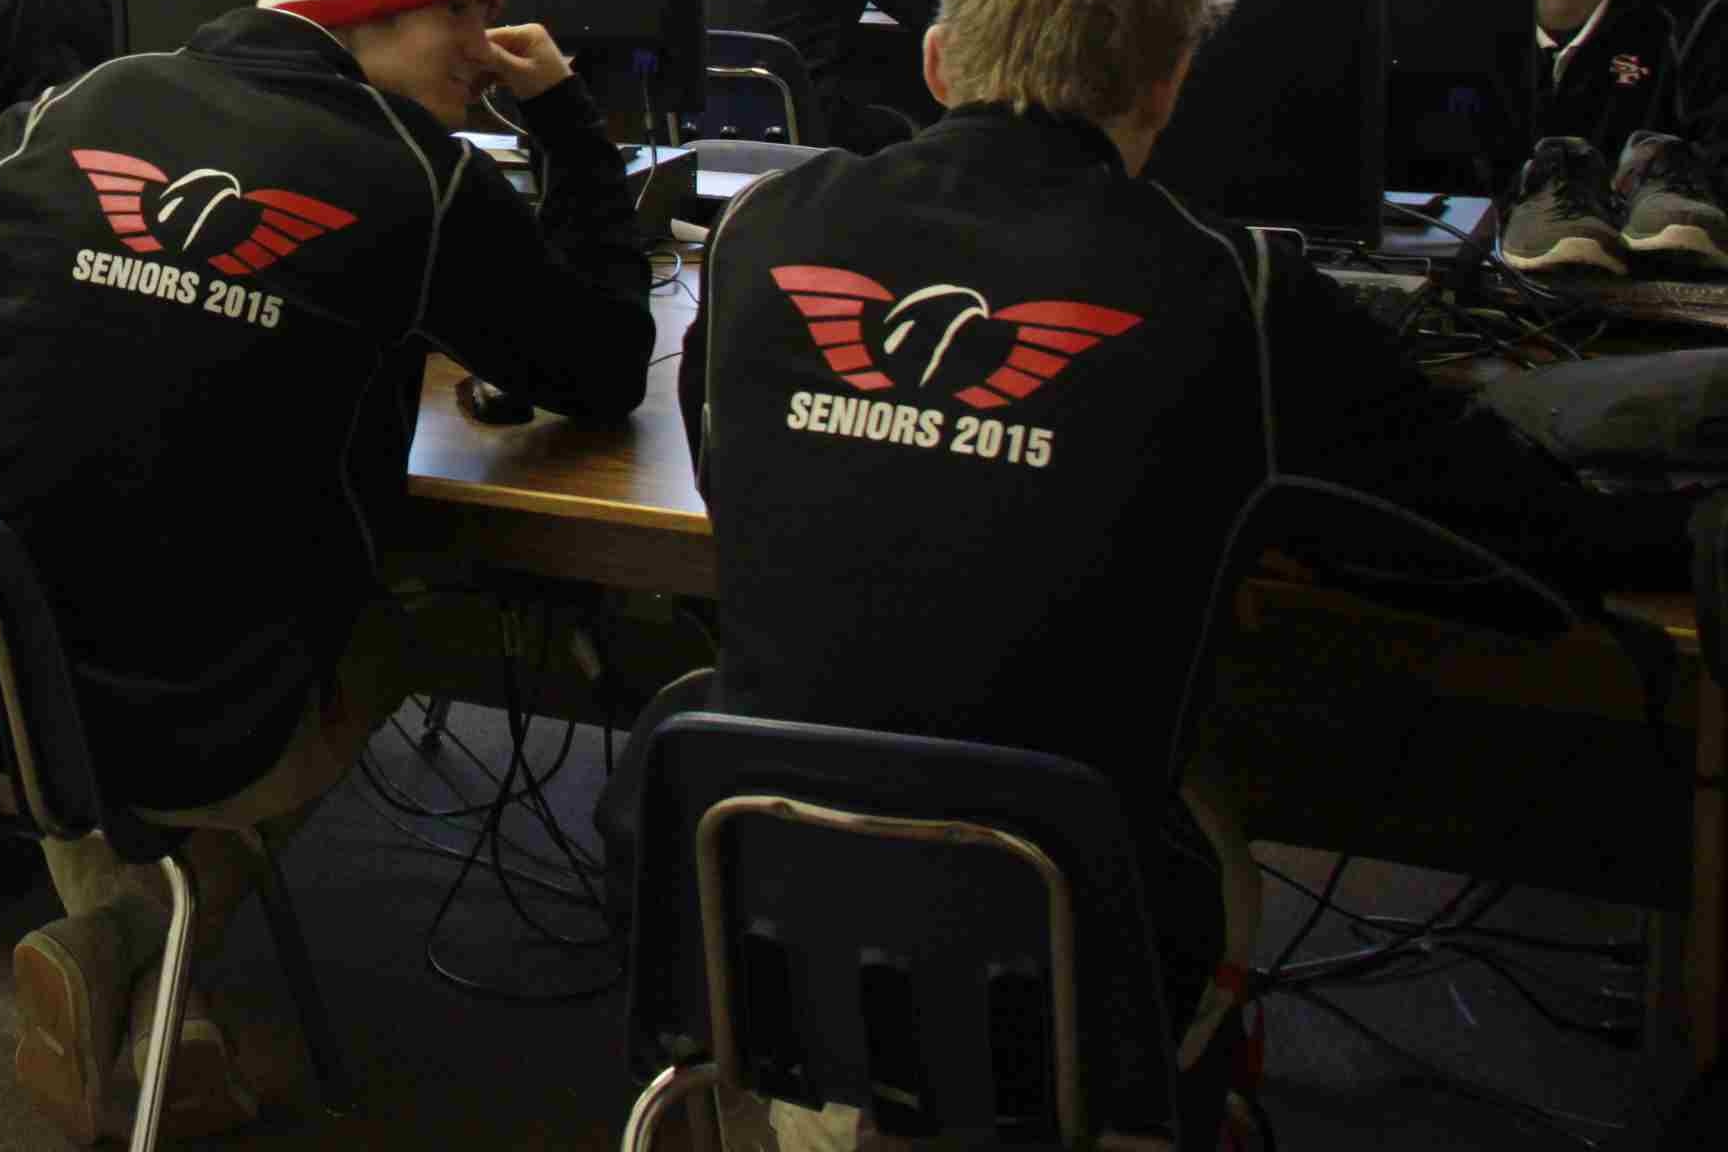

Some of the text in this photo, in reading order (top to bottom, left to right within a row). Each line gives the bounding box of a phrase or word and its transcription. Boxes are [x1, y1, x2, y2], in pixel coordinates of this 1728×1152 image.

[72, 248, 284, 328] SENIORS 2015
[786, 391, 1055, 468] SENIORS 2015
